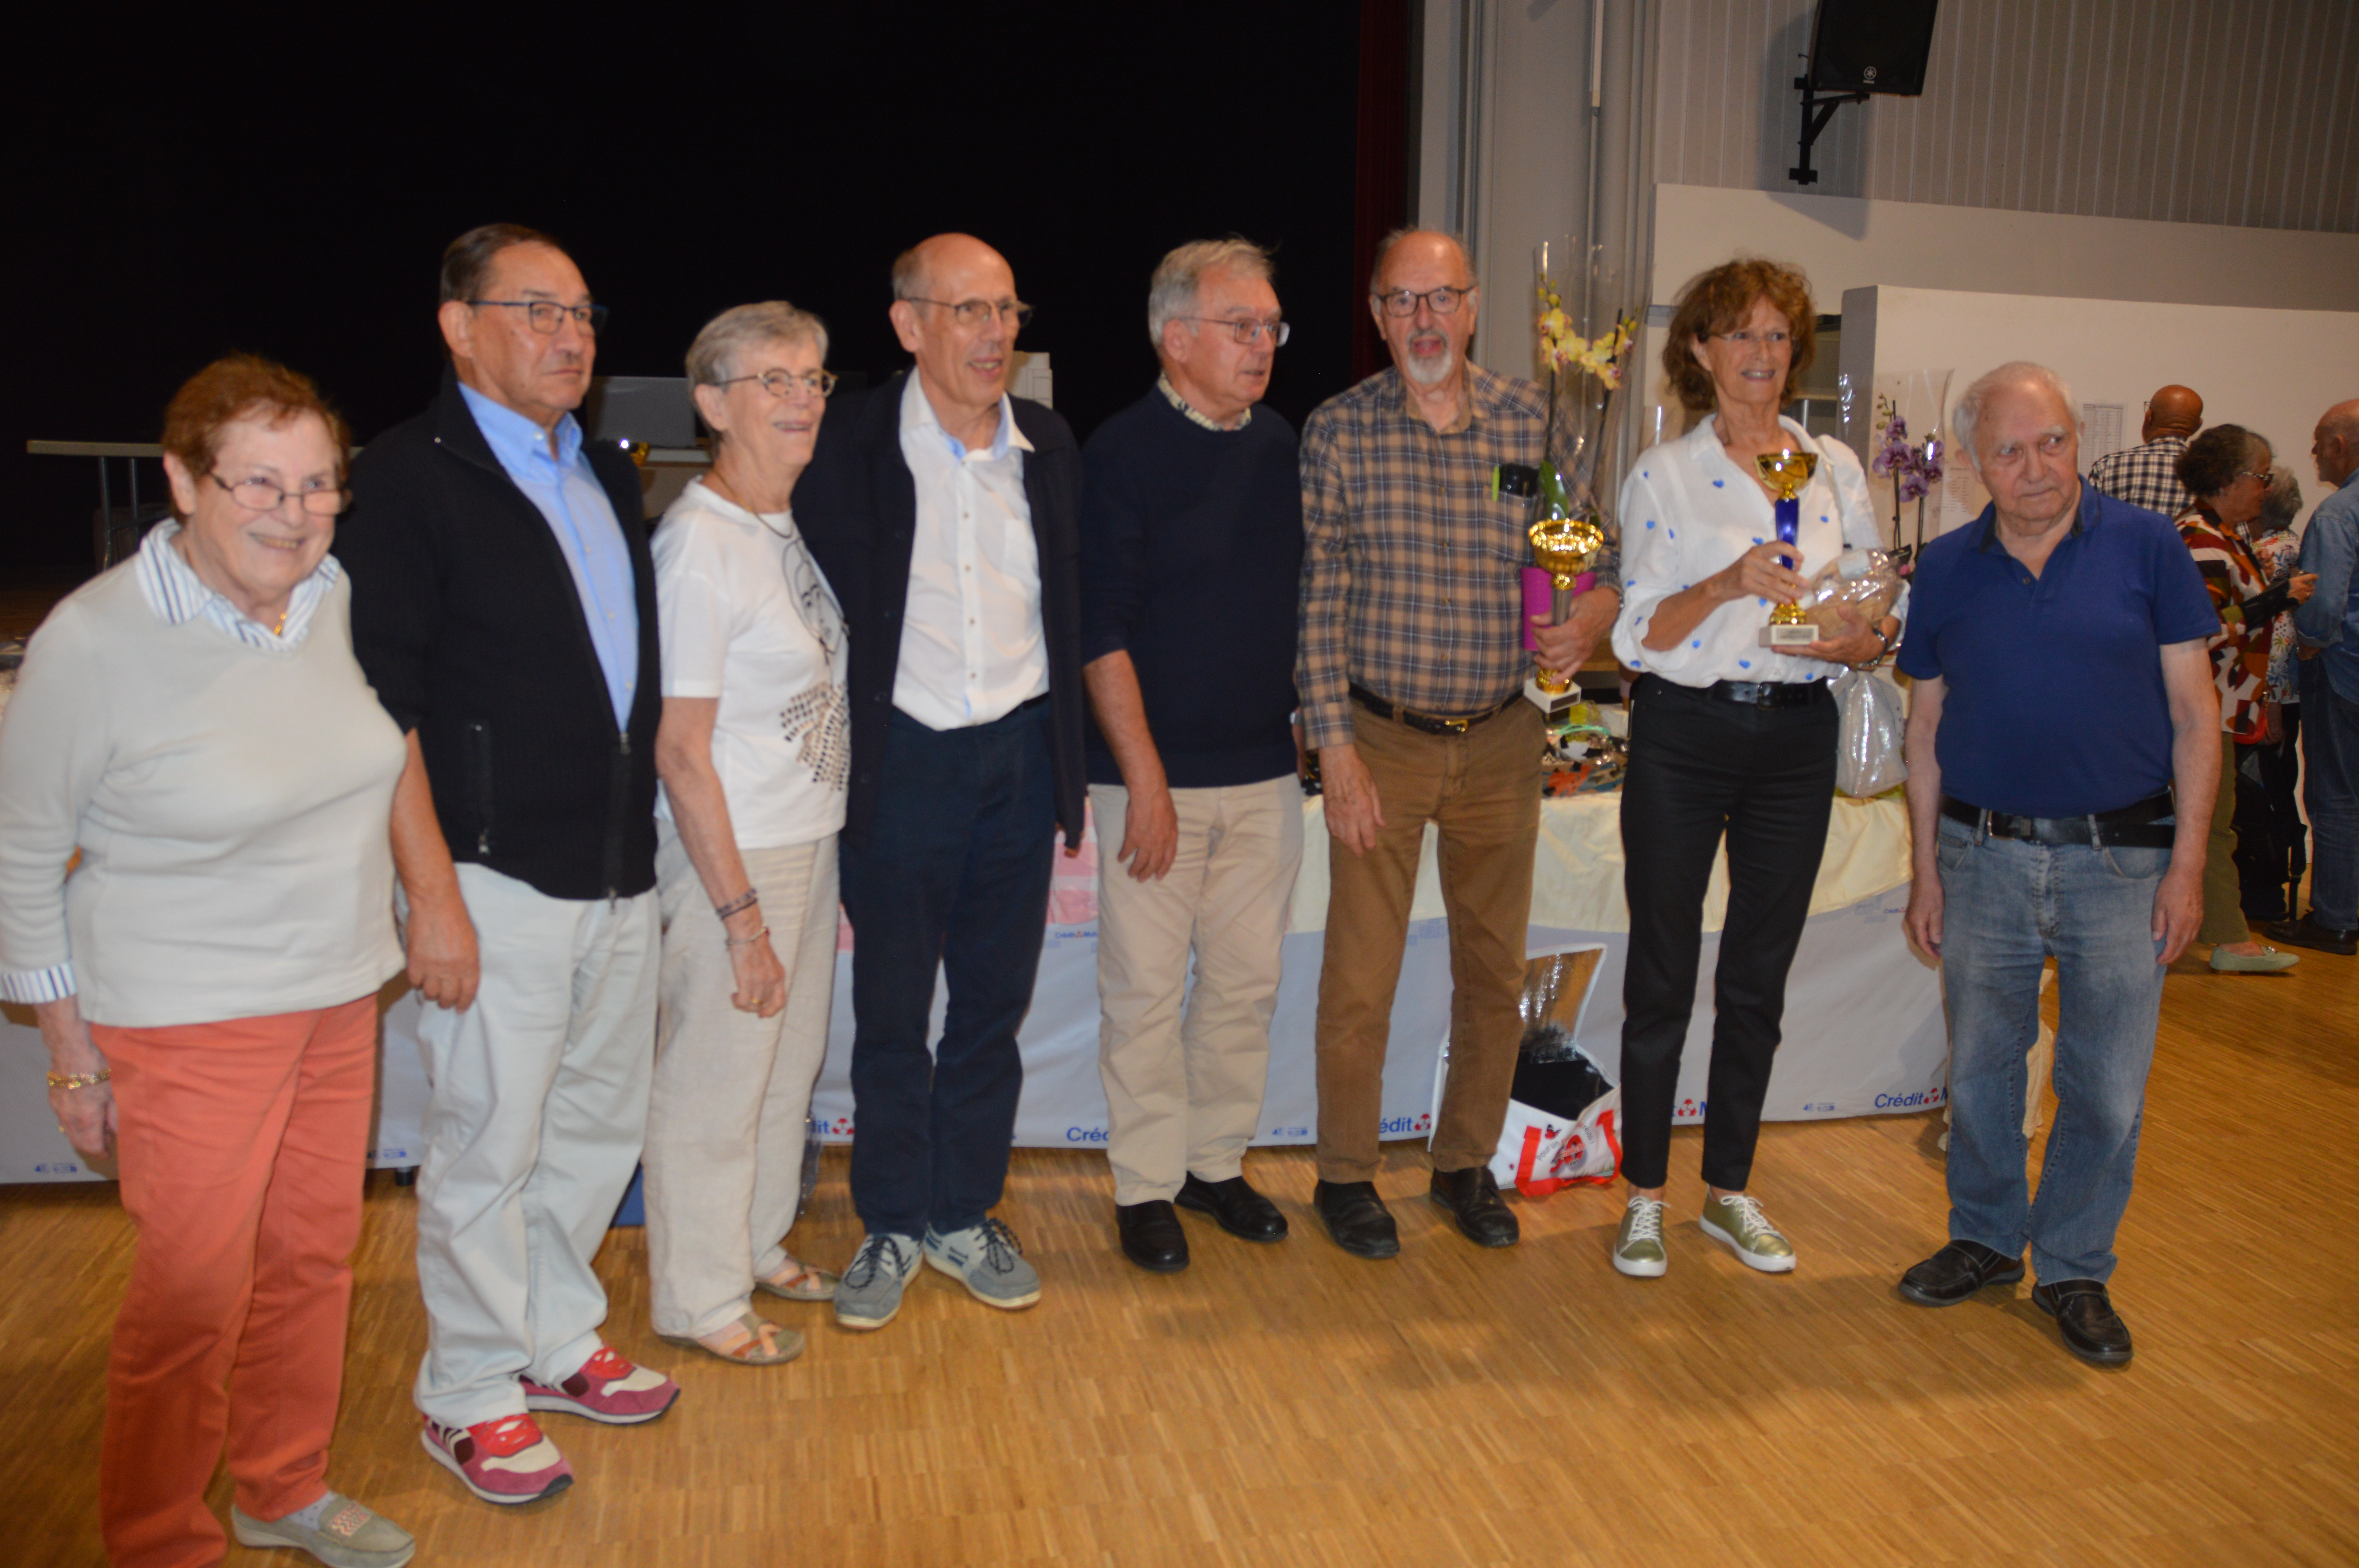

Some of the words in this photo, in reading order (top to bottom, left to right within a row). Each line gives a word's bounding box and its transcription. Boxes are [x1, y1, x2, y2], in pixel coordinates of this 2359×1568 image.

[1875, 1093, 1923, 1108] Crédit
[1379, 1117, 1412, 1134] édit
[1067, 1127, 1109, 1142] Cré
